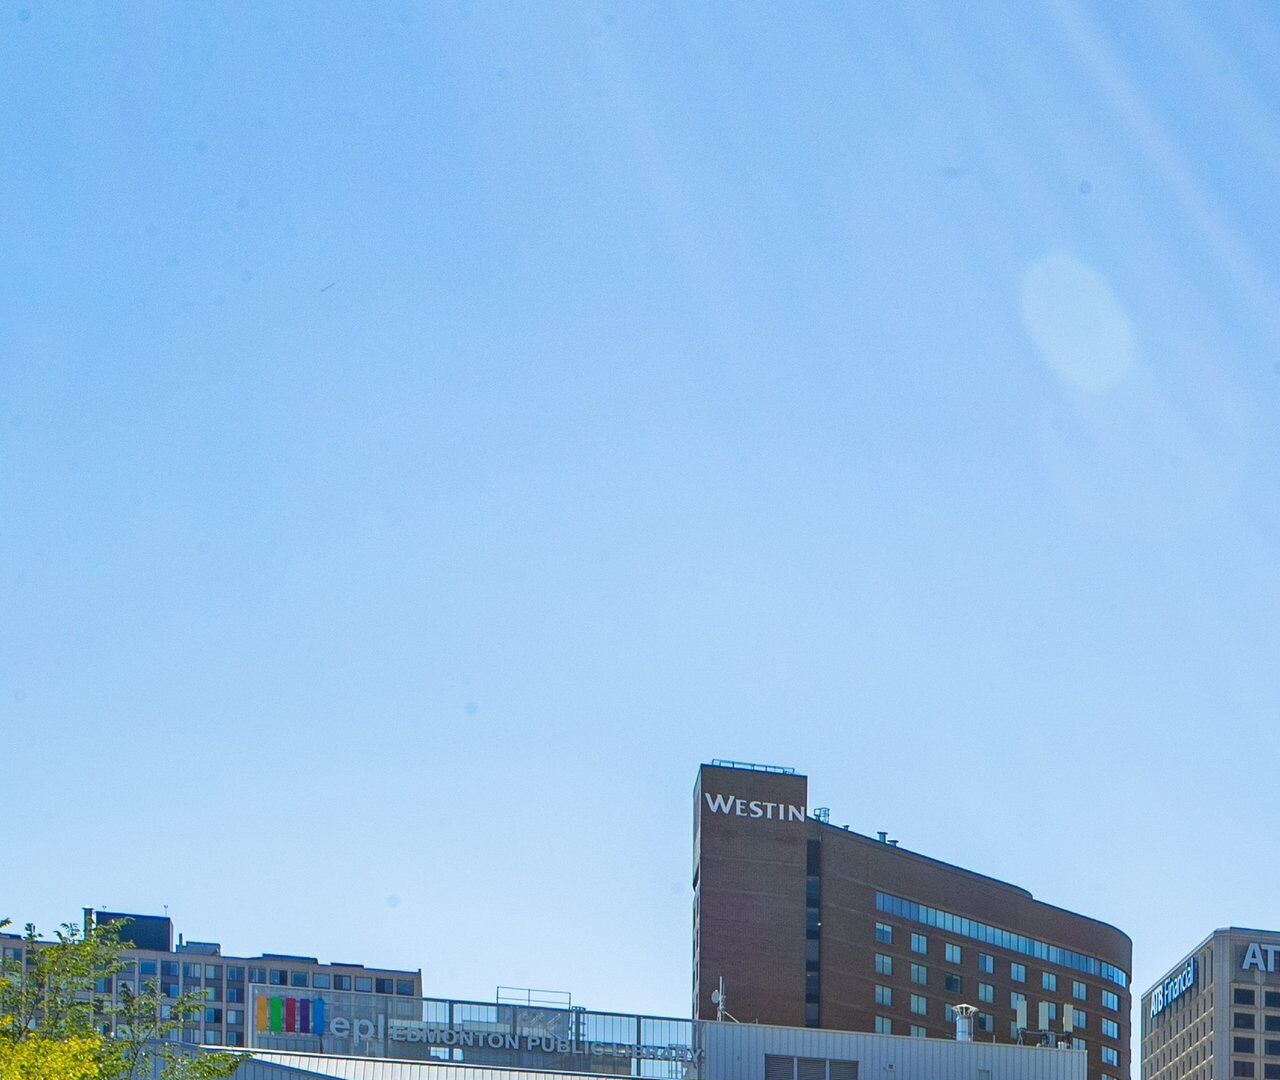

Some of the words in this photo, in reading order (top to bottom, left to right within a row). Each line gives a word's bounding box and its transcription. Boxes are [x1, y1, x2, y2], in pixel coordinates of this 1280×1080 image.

[705, 793, 804, 822] WESTIN
[1151, 985, 1163, 1018] ATB
[1164, 957, 1194, 1007] Financial
[329, 1014, 385, 1046] epl
[392, 1026, 519, 1050] EDMONTON
[527, 1037, 605, 1057] PUBLIC
